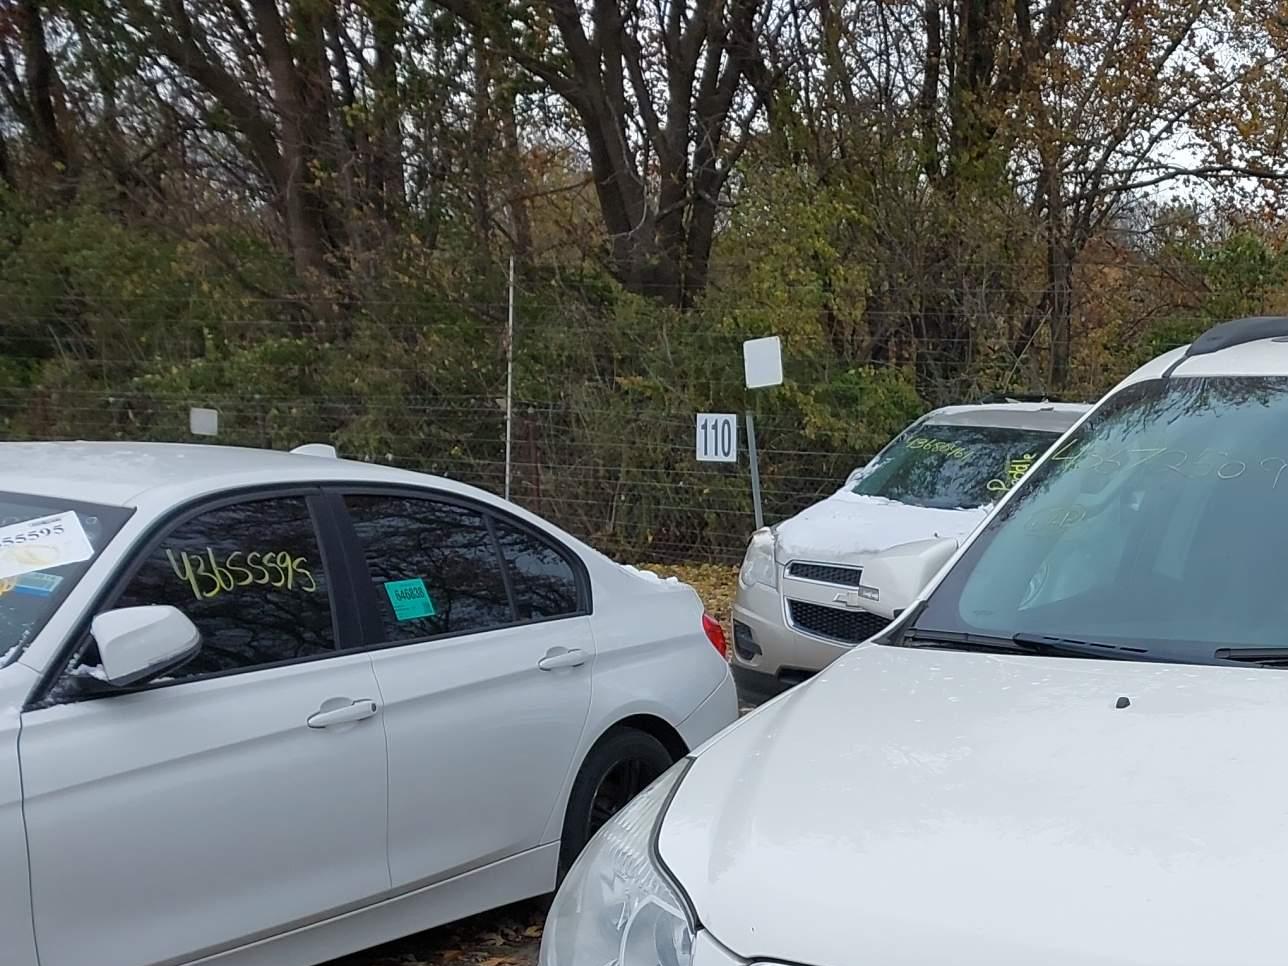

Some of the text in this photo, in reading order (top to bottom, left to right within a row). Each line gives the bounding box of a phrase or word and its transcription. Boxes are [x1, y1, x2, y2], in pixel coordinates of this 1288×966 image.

[700, 418, 732, 457] 110
[0, 524, 64, 548] 55595
[166, 547, 316, 600] 43655595
